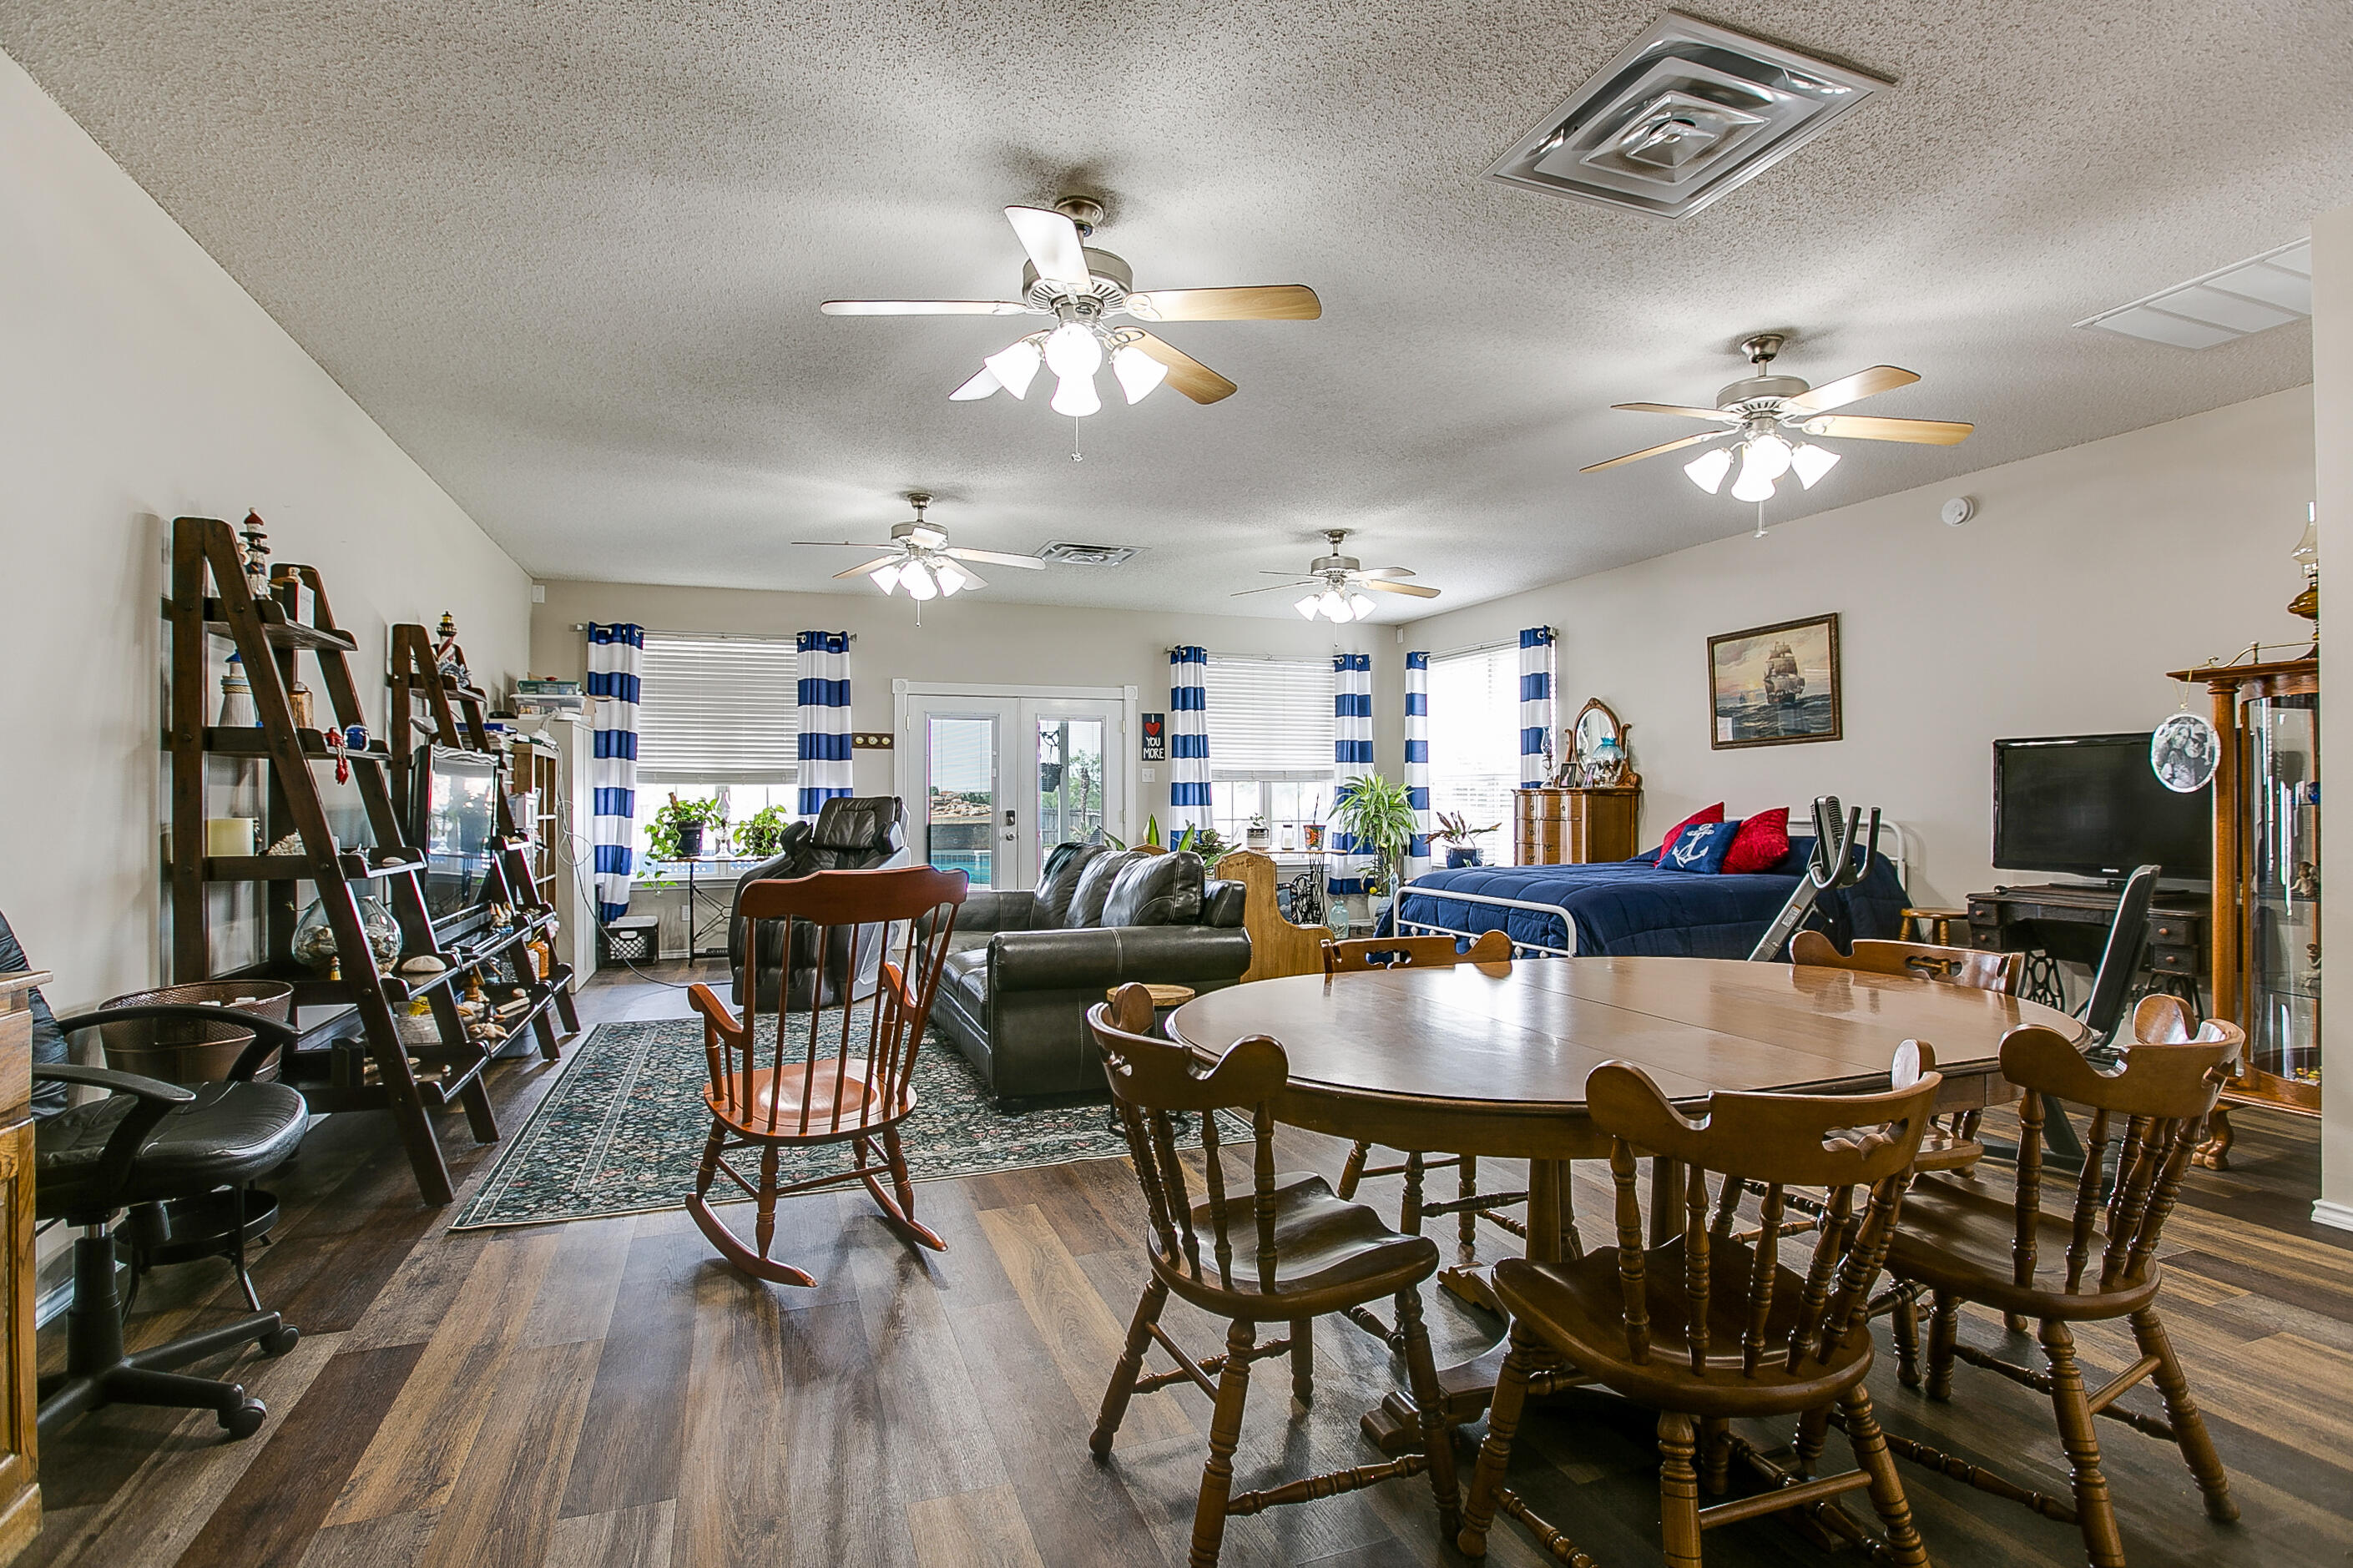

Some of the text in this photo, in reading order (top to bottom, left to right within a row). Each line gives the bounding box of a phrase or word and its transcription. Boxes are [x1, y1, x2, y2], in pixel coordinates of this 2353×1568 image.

[1151, 714, 1154, 723] I
[1145, 737, 1160, 747] YOU
[1143, 747, 1164, 759] MORE
